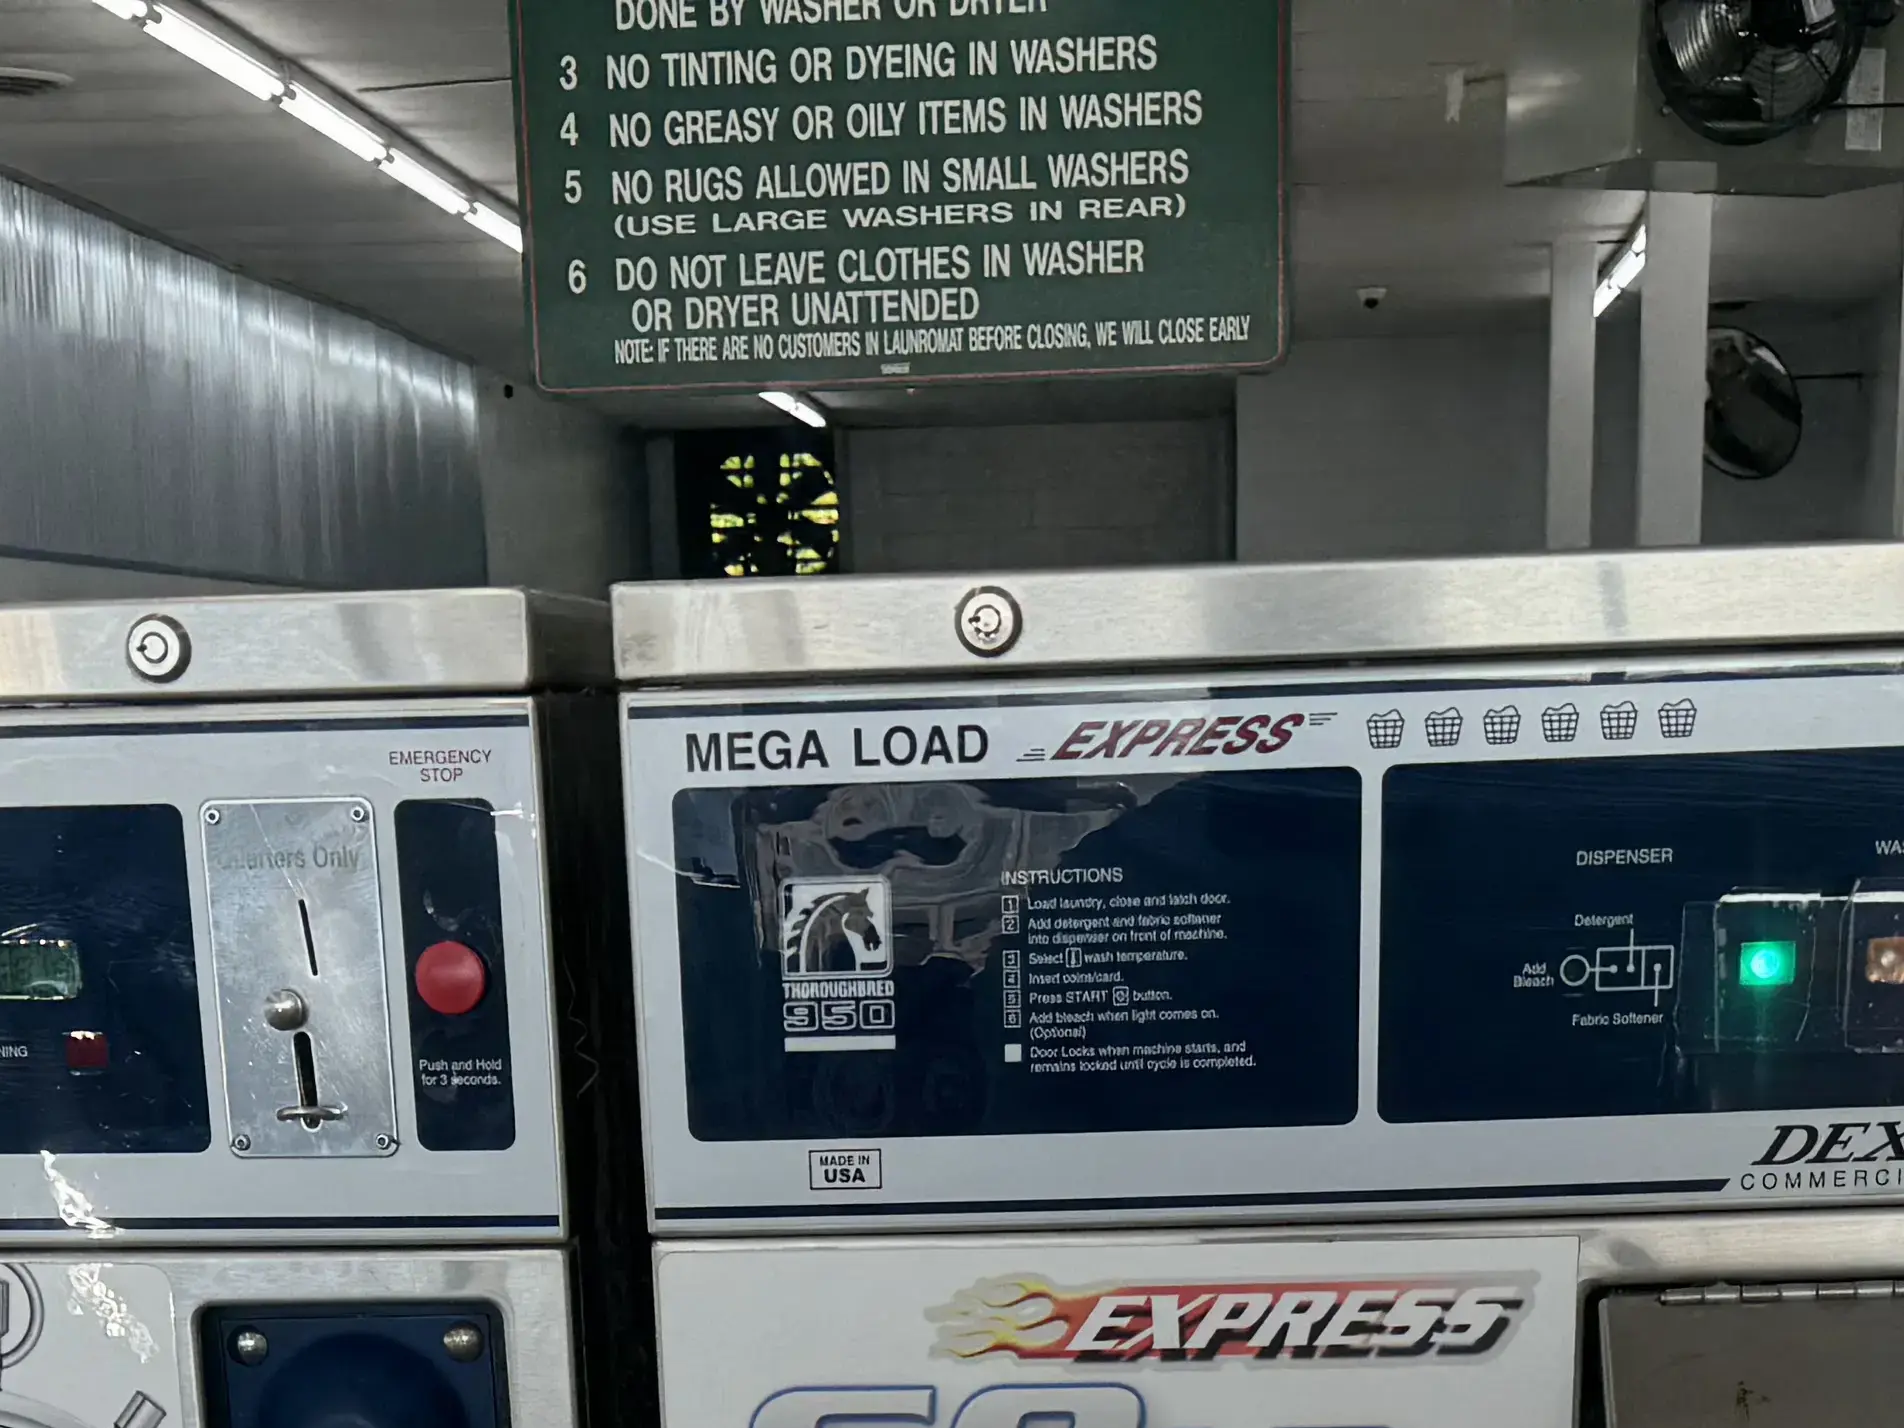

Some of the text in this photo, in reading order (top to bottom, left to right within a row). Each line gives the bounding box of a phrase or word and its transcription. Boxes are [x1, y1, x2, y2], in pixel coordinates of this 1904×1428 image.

[616, 0, 697, 30] DONE
[710, 0, 744, 26] BY
[560, 35, 1157, 90] 3 NO TINTING OR DYEING IN WASHERS
[561, 90, 1202, 147] 4 NO GREASY OR OILY ITEMS IN WASHERS
[565, 149, 1188, 204] 5 NO RUGS ALLOWED IN SMALL WASHERS
[615, 194, 1185, 238] (USE LARGE WASHERS IN REAR)
[569, 240, 1143, 294] 6 DO NOT LEAVE CLOTHES IN WASHER
[632, 287, 979, 332] OR DRYER UNATTENDED
[615, 315, 1250, 364] NOTE: IF THERE ARE NO CUSTOMERS IN LAUNROMAT BEFORE CLOSING, WE WILL CLOSE EARLY
[389, 749, 491, 765] EMERGENCY
[686, 714, 1305, 772] MEGA LOAD EXPRESS
[420, 768, 463, 782] STOP
[1577, 848, 1673, 865] DISPENSER
[1001, 867, 1123, 885] INSTRUCTIONS
[783, 999, 895, 1032] 950
[419, 1059, 502, 1072] Push and Hold
[422, 1073, 502, 1086] for 3 seconds.
[820, 1156, 869, 1166] MADE IN
[824, 1168, 865, 1183] USA
[1066, 1292, 1505, 1353] EXPRESS
